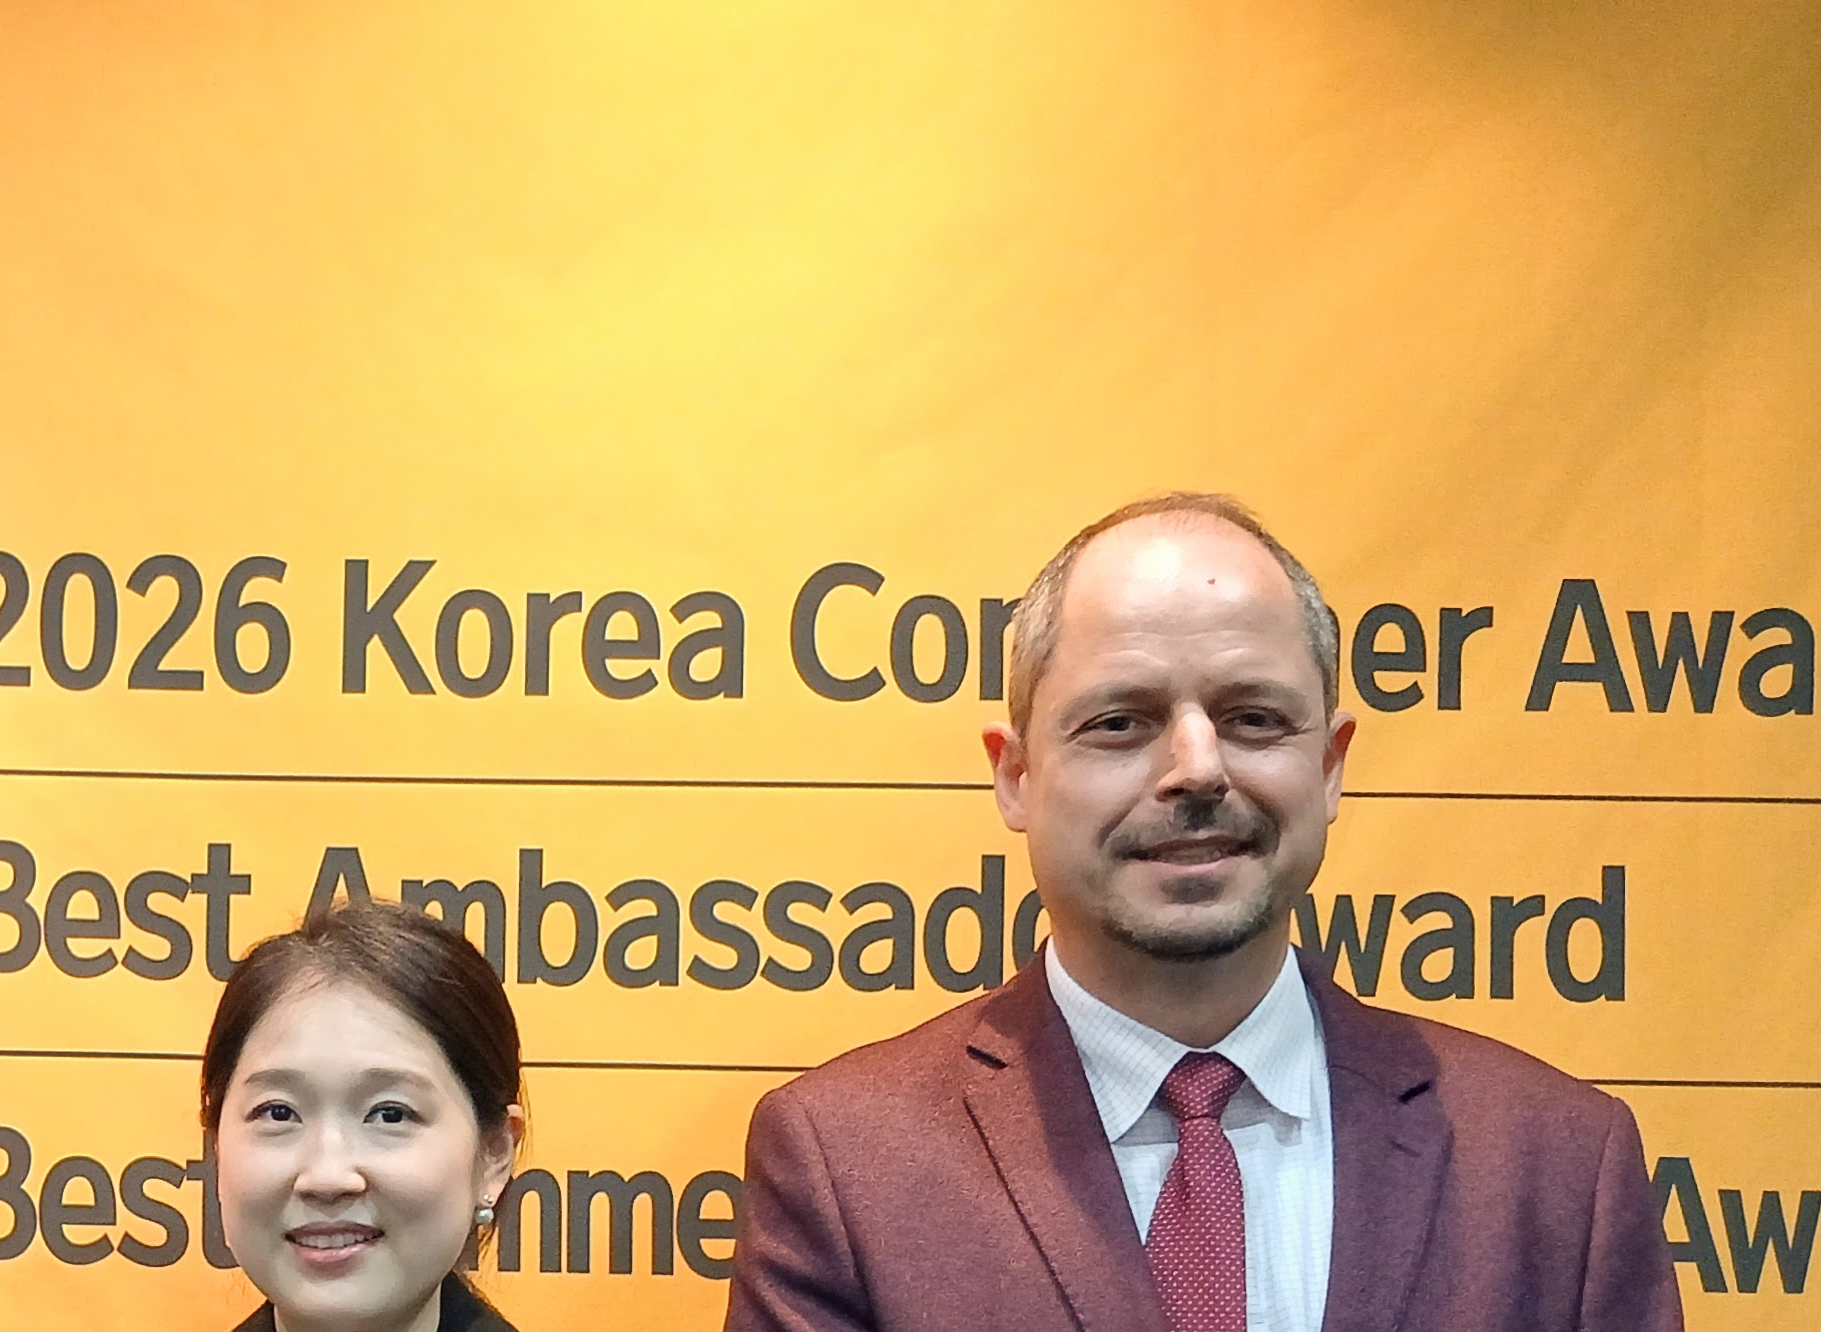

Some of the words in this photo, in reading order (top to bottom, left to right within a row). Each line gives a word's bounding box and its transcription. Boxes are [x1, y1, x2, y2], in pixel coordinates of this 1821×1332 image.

[341, 559, 745, 700] Korea
[790, 562, 1494, 713] Coner
[302, 847, 1053, 993] Ambassad
[1289, 865, 1626, 1002] ward
